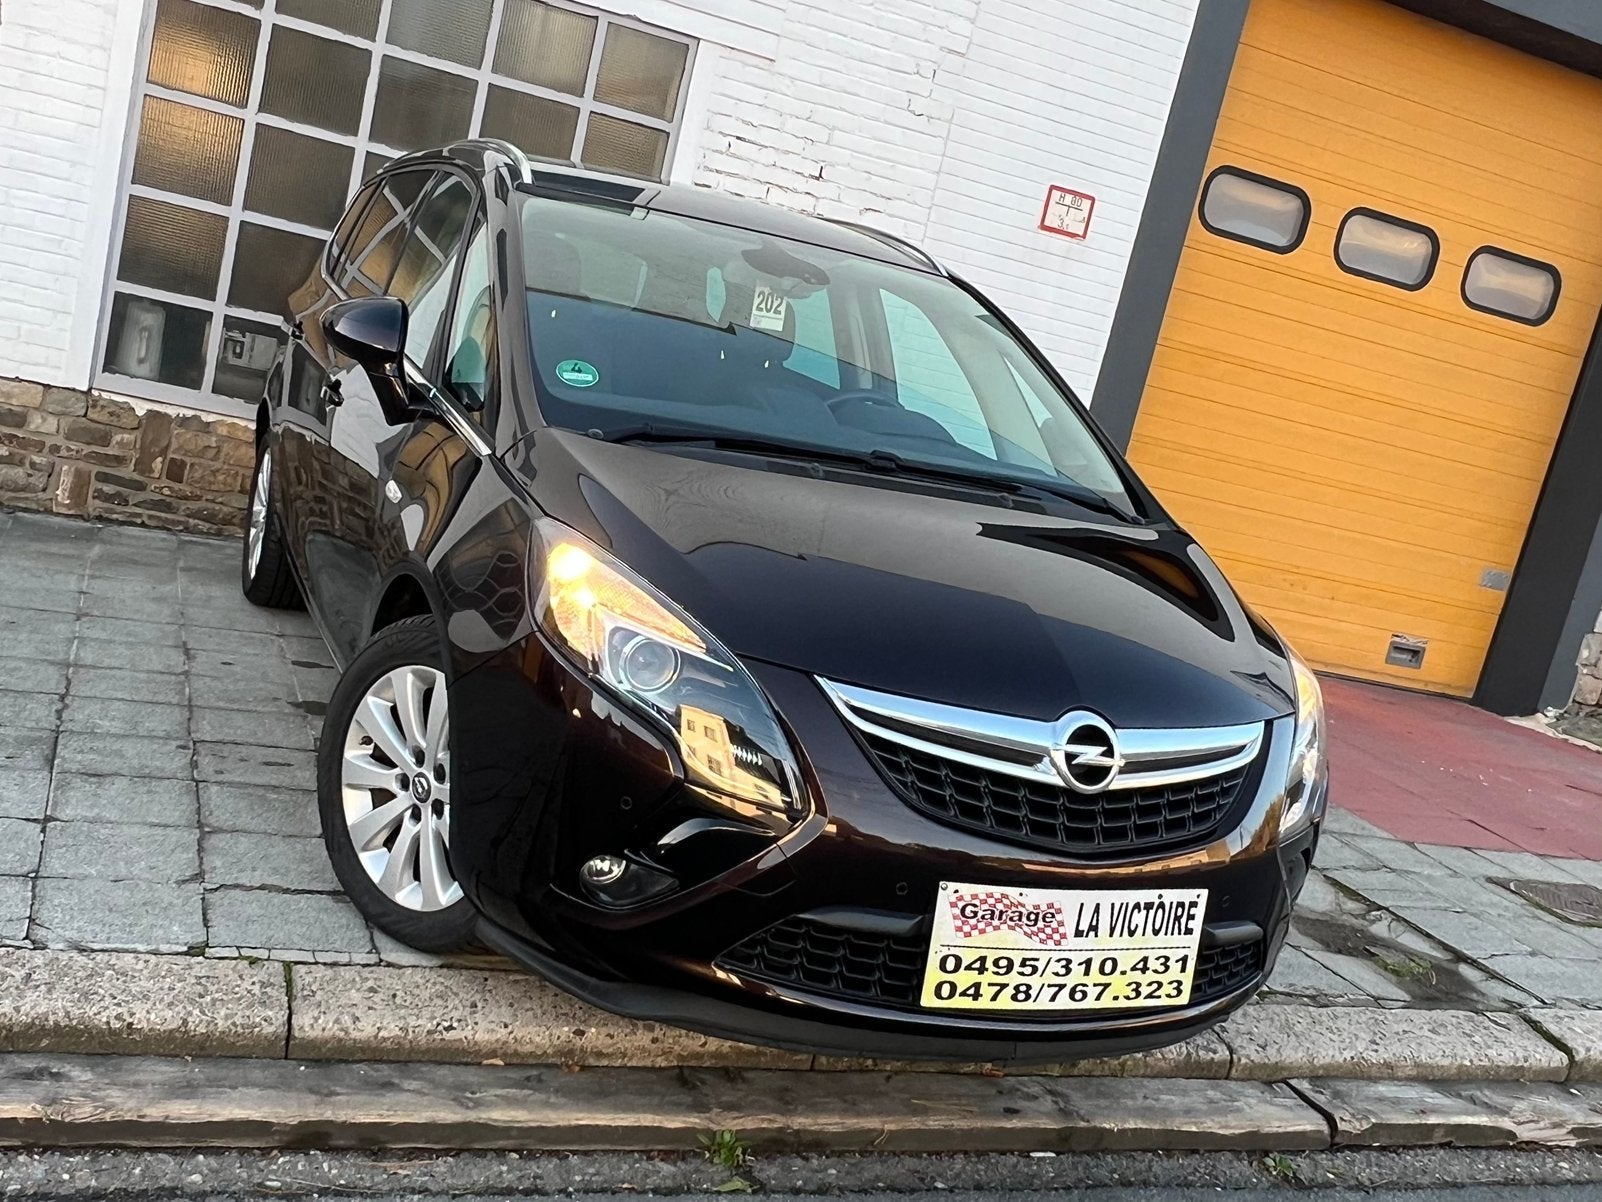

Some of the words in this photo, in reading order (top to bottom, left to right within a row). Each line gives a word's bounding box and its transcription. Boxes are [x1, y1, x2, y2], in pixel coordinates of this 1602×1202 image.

[755, 290, 784, 315] 202
[570, 362, 583, 374] 4
[959, 902, 1056, 927] Garage
[1073, 901, 1101, 938] LA
[1109, 899, 1199, 938] VICTOIRE
[938, 953, 1190, 978] 0495/310.431
[933, 979, 1184, 1003] 0478/767.323
